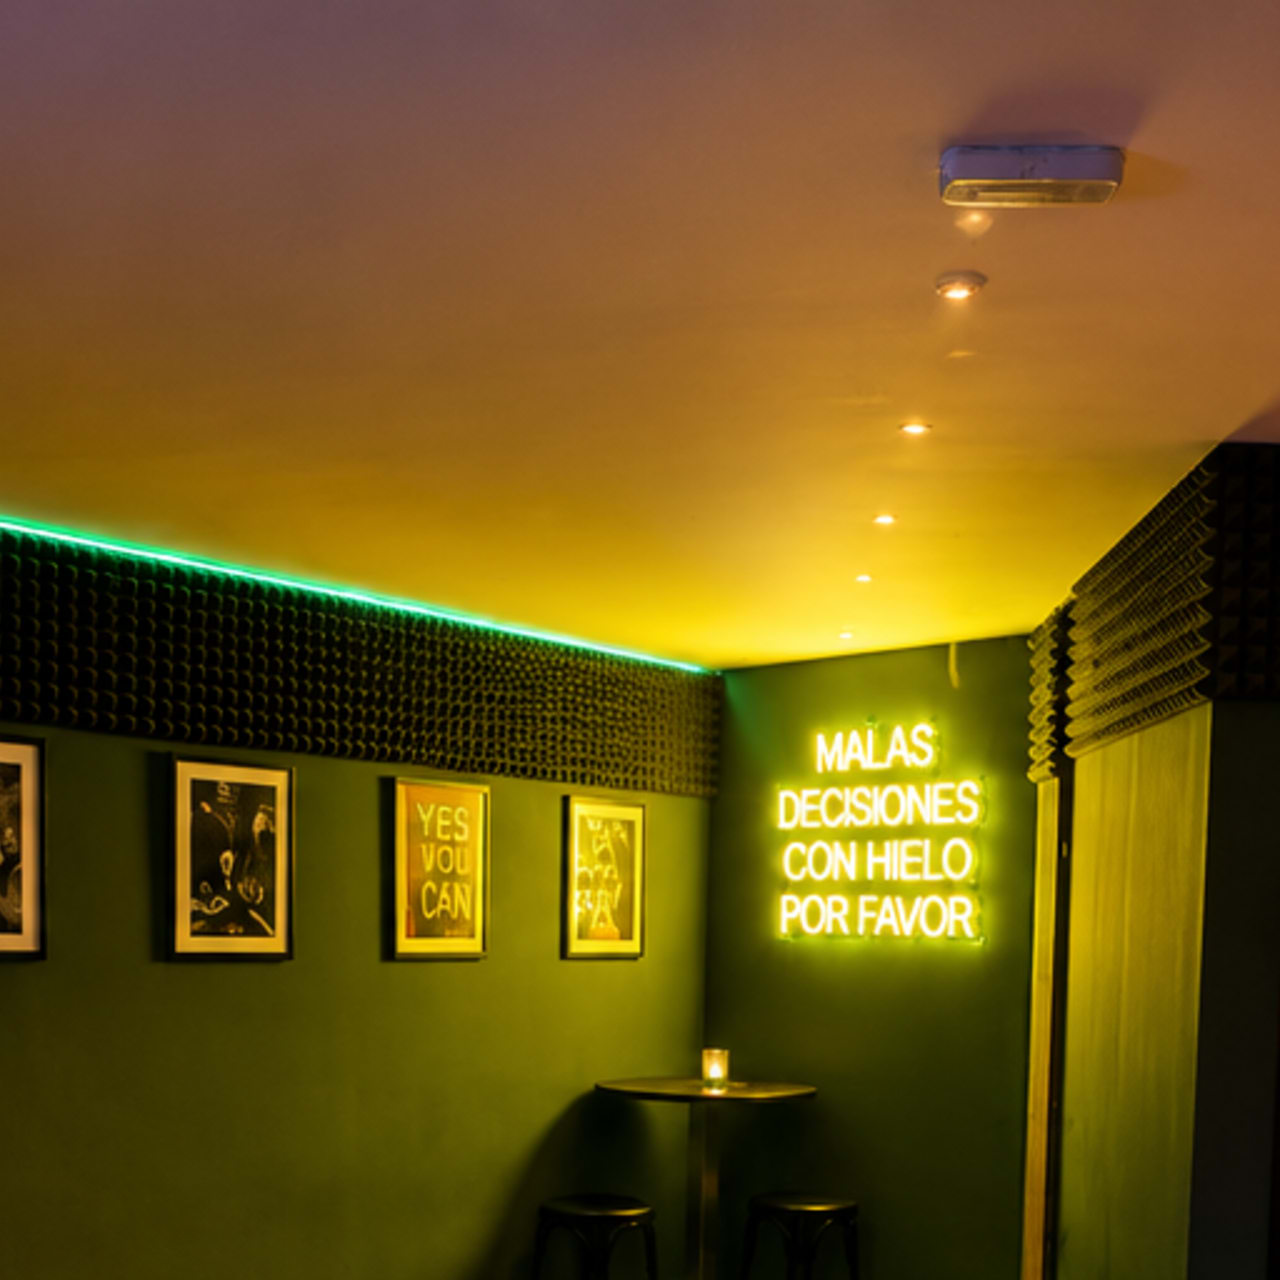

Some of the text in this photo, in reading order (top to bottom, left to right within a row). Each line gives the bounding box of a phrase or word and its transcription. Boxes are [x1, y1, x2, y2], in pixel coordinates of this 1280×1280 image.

[815, 723, 935, 774] MALAS
[416, 802, 470, 842] YES
[777, 780, 981, 830] DECISIONES
[782, 837, 975, 882] CON HIELO
[421, 879, 473, 921] CAN
[779, 893, 976, 939] POR FAVOR
